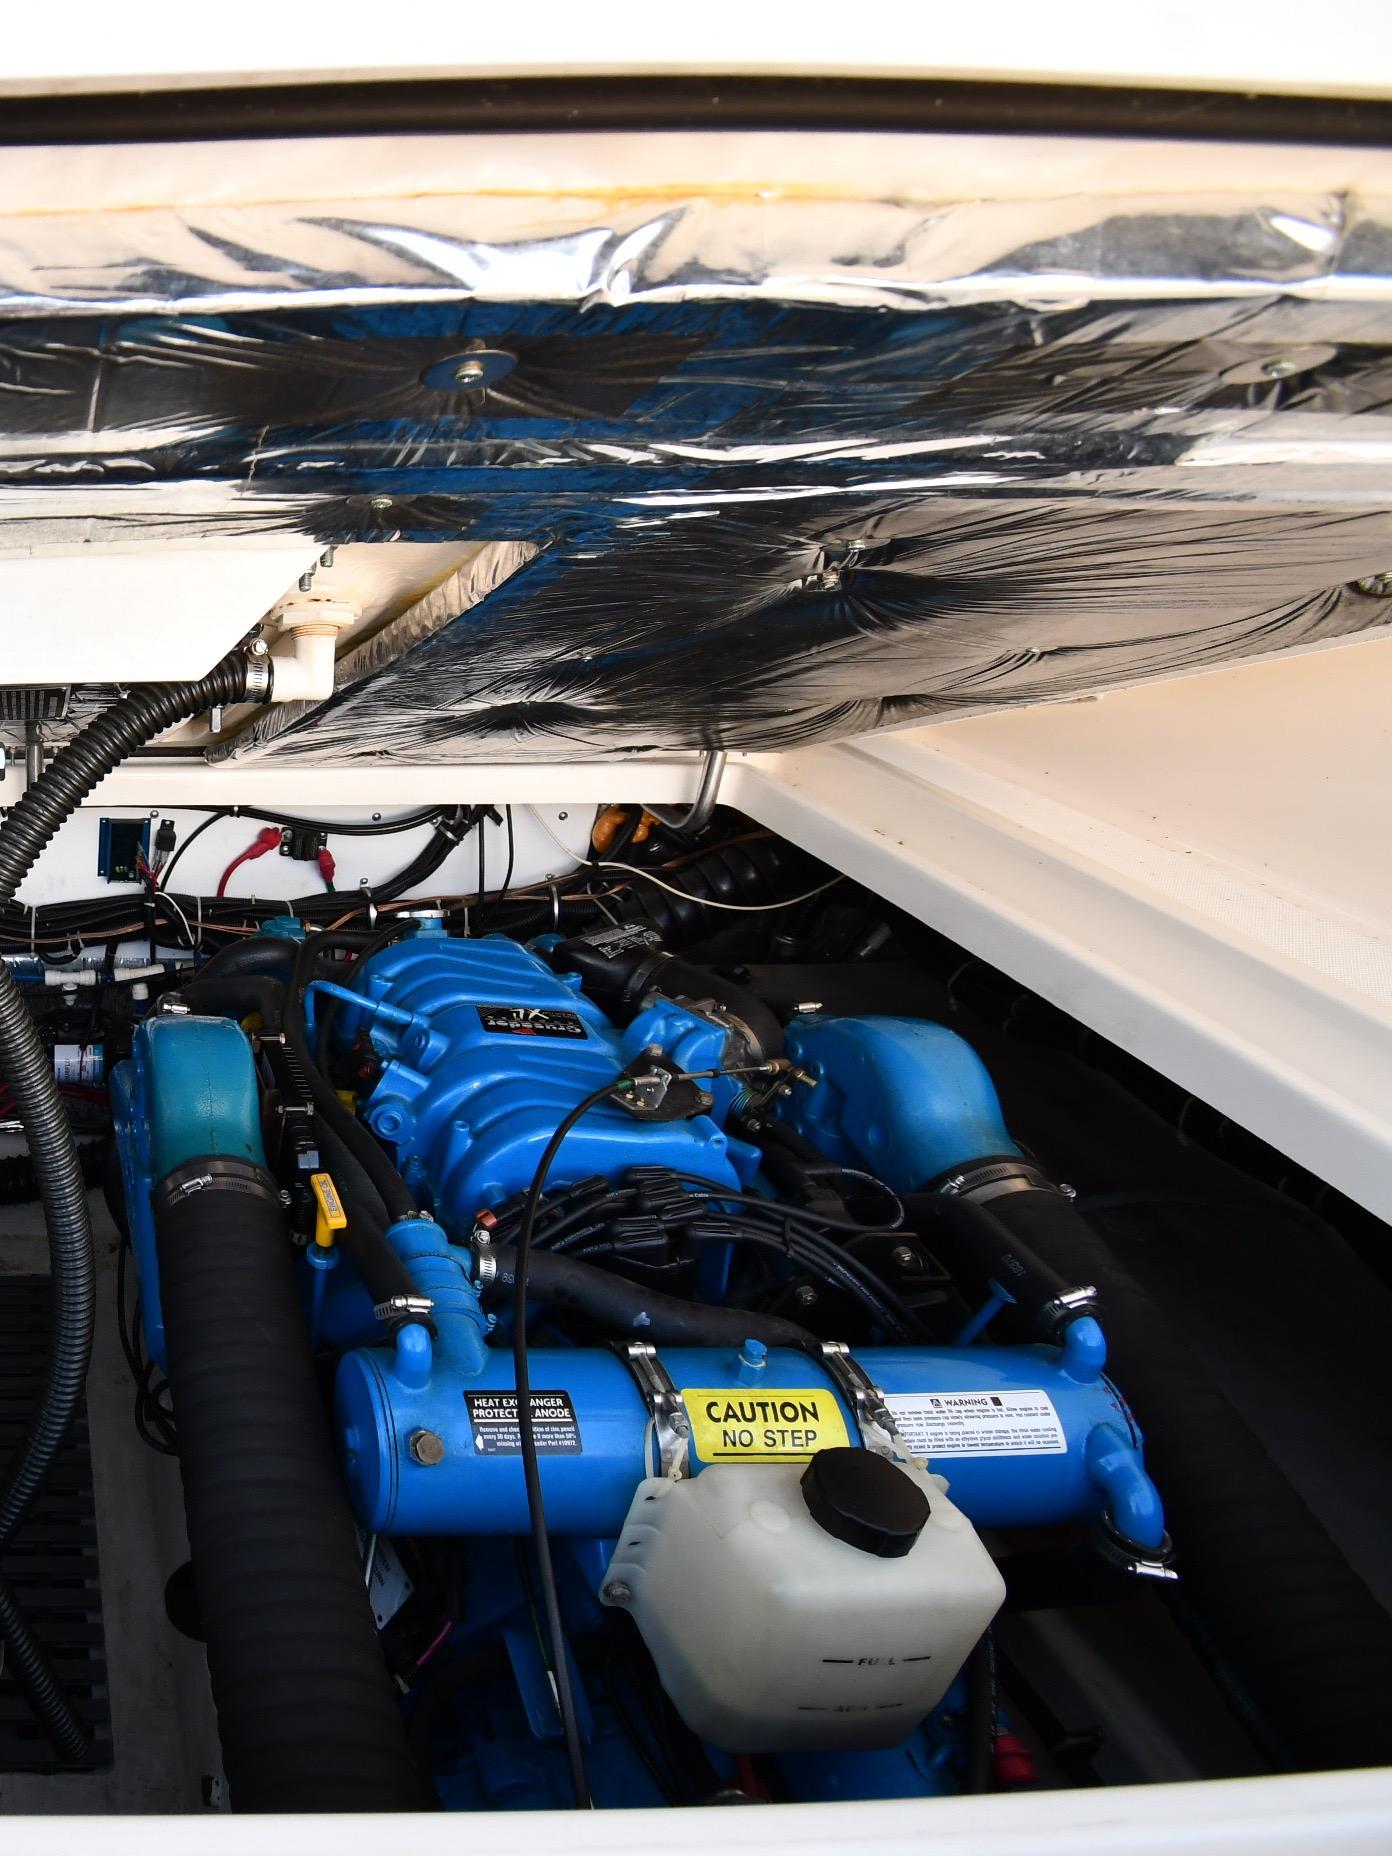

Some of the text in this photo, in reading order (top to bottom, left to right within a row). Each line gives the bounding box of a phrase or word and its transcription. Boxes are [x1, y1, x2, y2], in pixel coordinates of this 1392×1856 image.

[324, 1190, 338, 1212] ENGINE
[474, 1398, 564, 1408] HEAT EXANGER
[944, 1398, 988, 1406] WARNING
[473, 1408, 572, 1418] PROTECT ANODE
[706, 1401, 820, 1423] CAUTION
[722, 1430, 817, 1448] NO STEP
